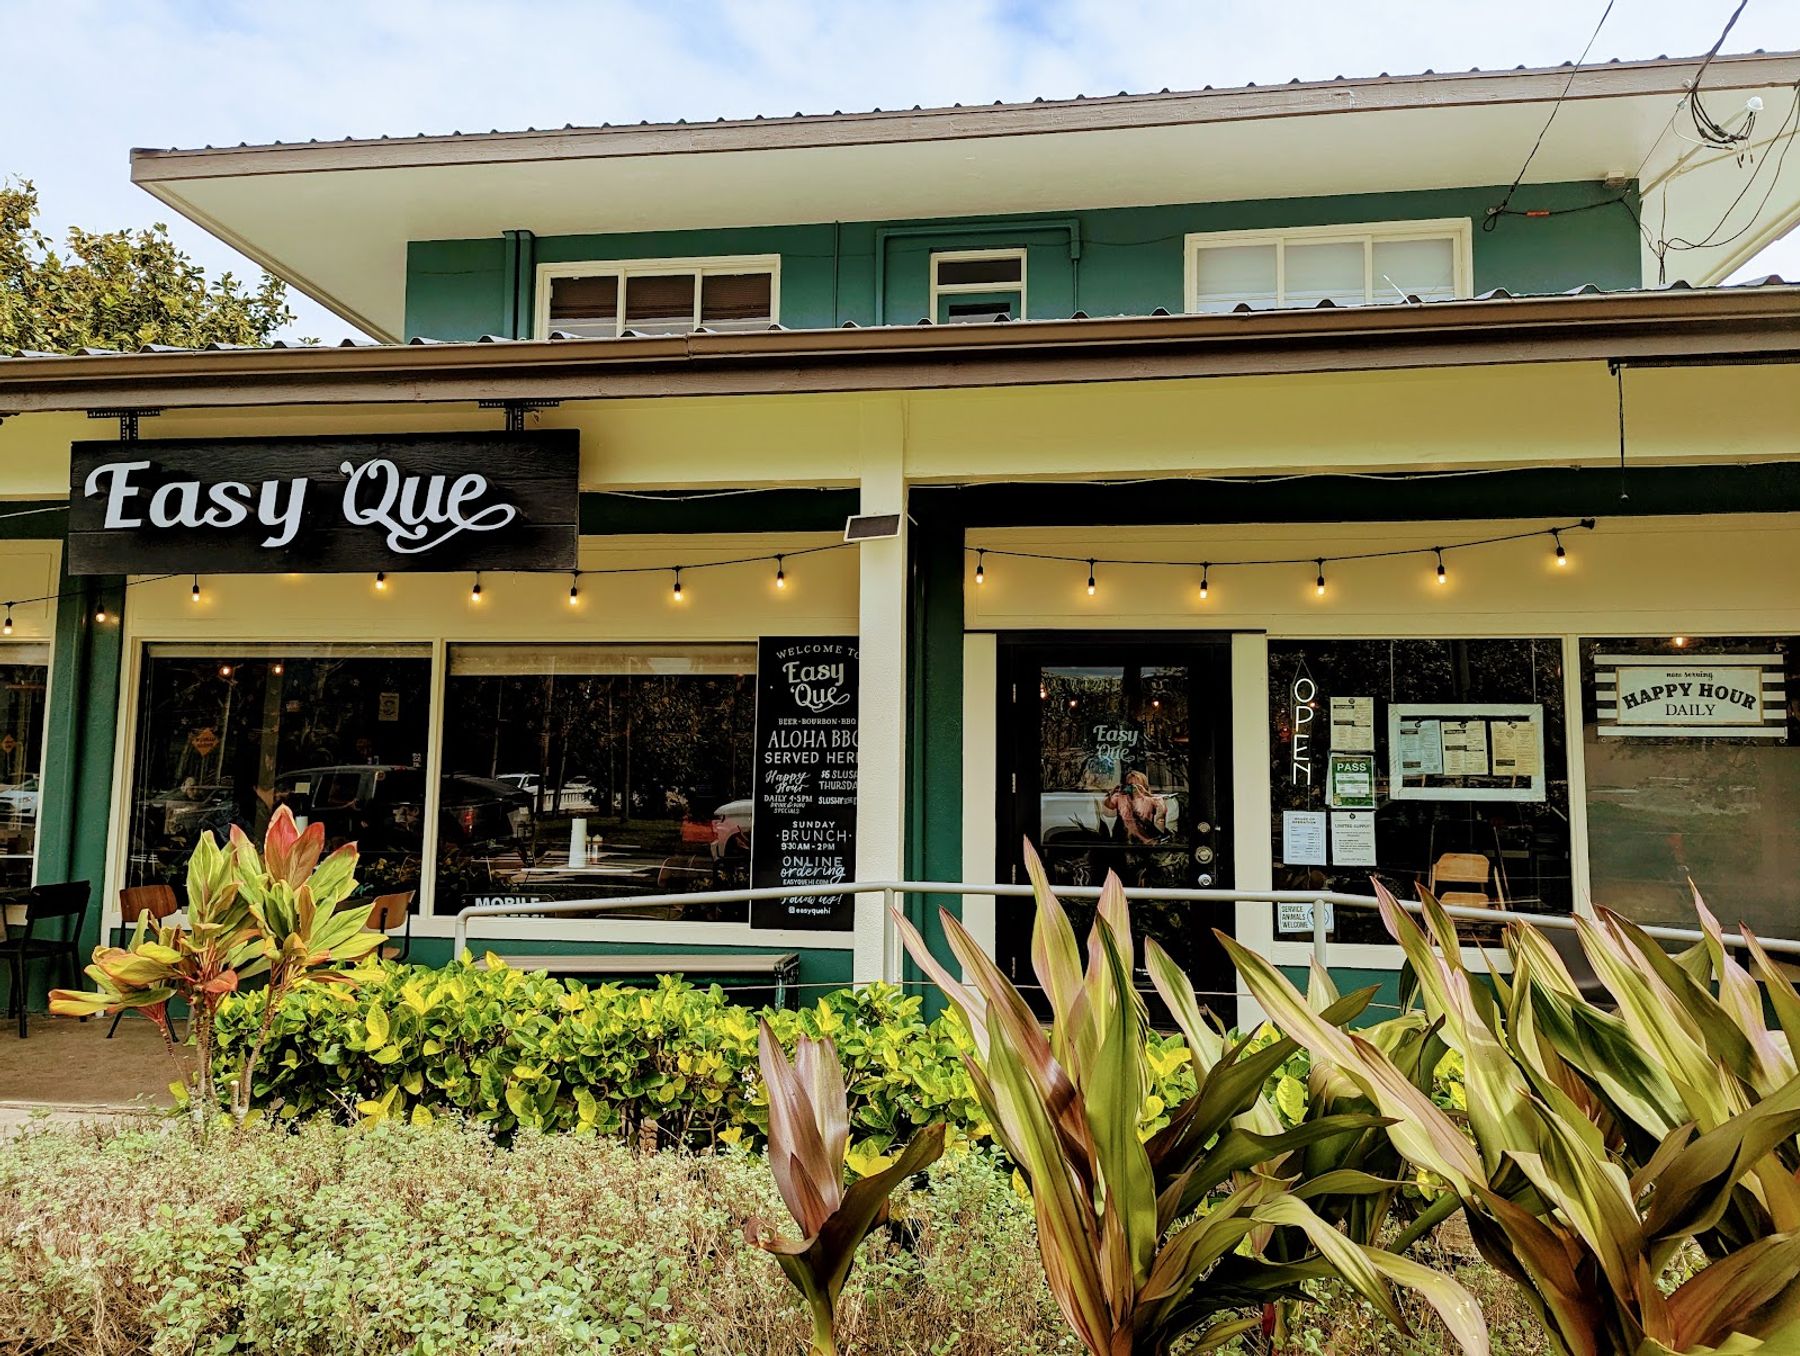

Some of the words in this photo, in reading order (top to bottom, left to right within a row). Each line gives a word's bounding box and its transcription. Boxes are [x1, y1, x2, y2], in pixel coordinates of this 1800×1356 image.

[84, 460, 308, 548] Easy
[776, 644, 843, 659] WELCOME
[782, 661, 844, 686] Easy
[1622, 682, 1693, 709] HAPPY
[1698, 682, 1757, 710] HOUR
[1665, 704, 1716, 716] DAILY
[1092, 724, 1139, 747] Easy
[1293, 678, 1316, 785] OPEN
[767, 730, 828, 748] ALOHA
[764, 751, 820, 764] SERVED
[1336, 762, 1367, 772] PASS
[765, 769, 811, 784] Happy
[774, 782, 810, 793] Hour
[763, 794, 788, 802] DAILY
[792, 820, 836, 829] SUNDAY
[781, 829, 847, 843] BRUNCH
[816, 842, 835, 850] 2PM
[782, 856, 843, 867] ONLINE
[780, 862, 846, 885] ordering
